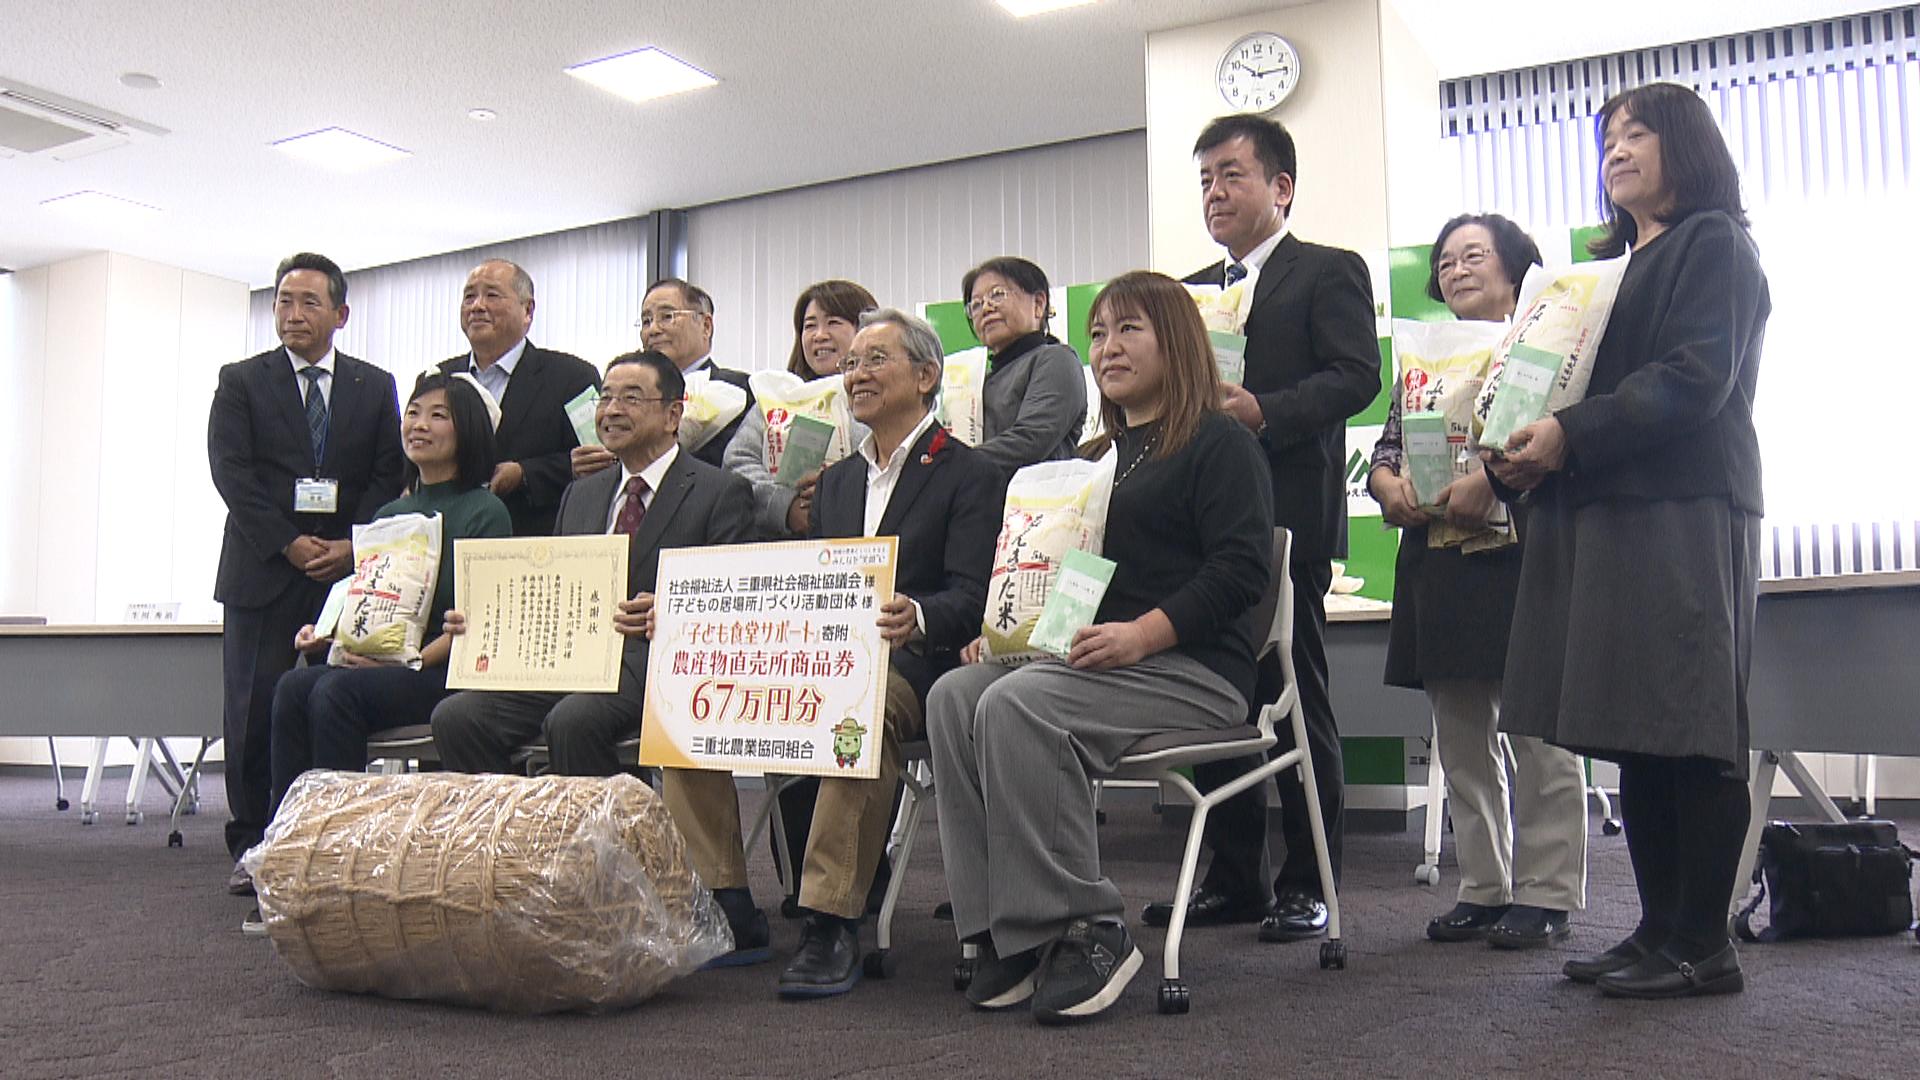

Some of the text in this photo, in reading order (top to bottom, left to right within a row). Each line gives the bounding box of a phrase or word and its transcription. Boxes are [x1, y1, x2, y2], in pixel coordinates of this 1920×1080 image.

[1253, 43, 1262, 53] 12
[1241, 49, 1249, 59] 11
[1278, 52, 1284, 63] 2
[1231, 60, 1241, 70] 10
[1228, 75, 1235, 85] 9
[1278, 80, 1284, 89] 4
[1232, 87, 1239, 97] 8
[1269, 90, 1276, 101] 5
[1244, 95, 1248, 105] 7
[1256, 96, 1262, 106] 6
[668, 572, 876, 595] 社会福祉法人 三重県社会福祉協議会 様
[862, 596, 873, 610] 様
[671, 649, 856, 678] 農産物直売所商品券
[691, 679, 824, 723] 67万円分
[690, 735, 815, 760] 三重北農業協同組合
